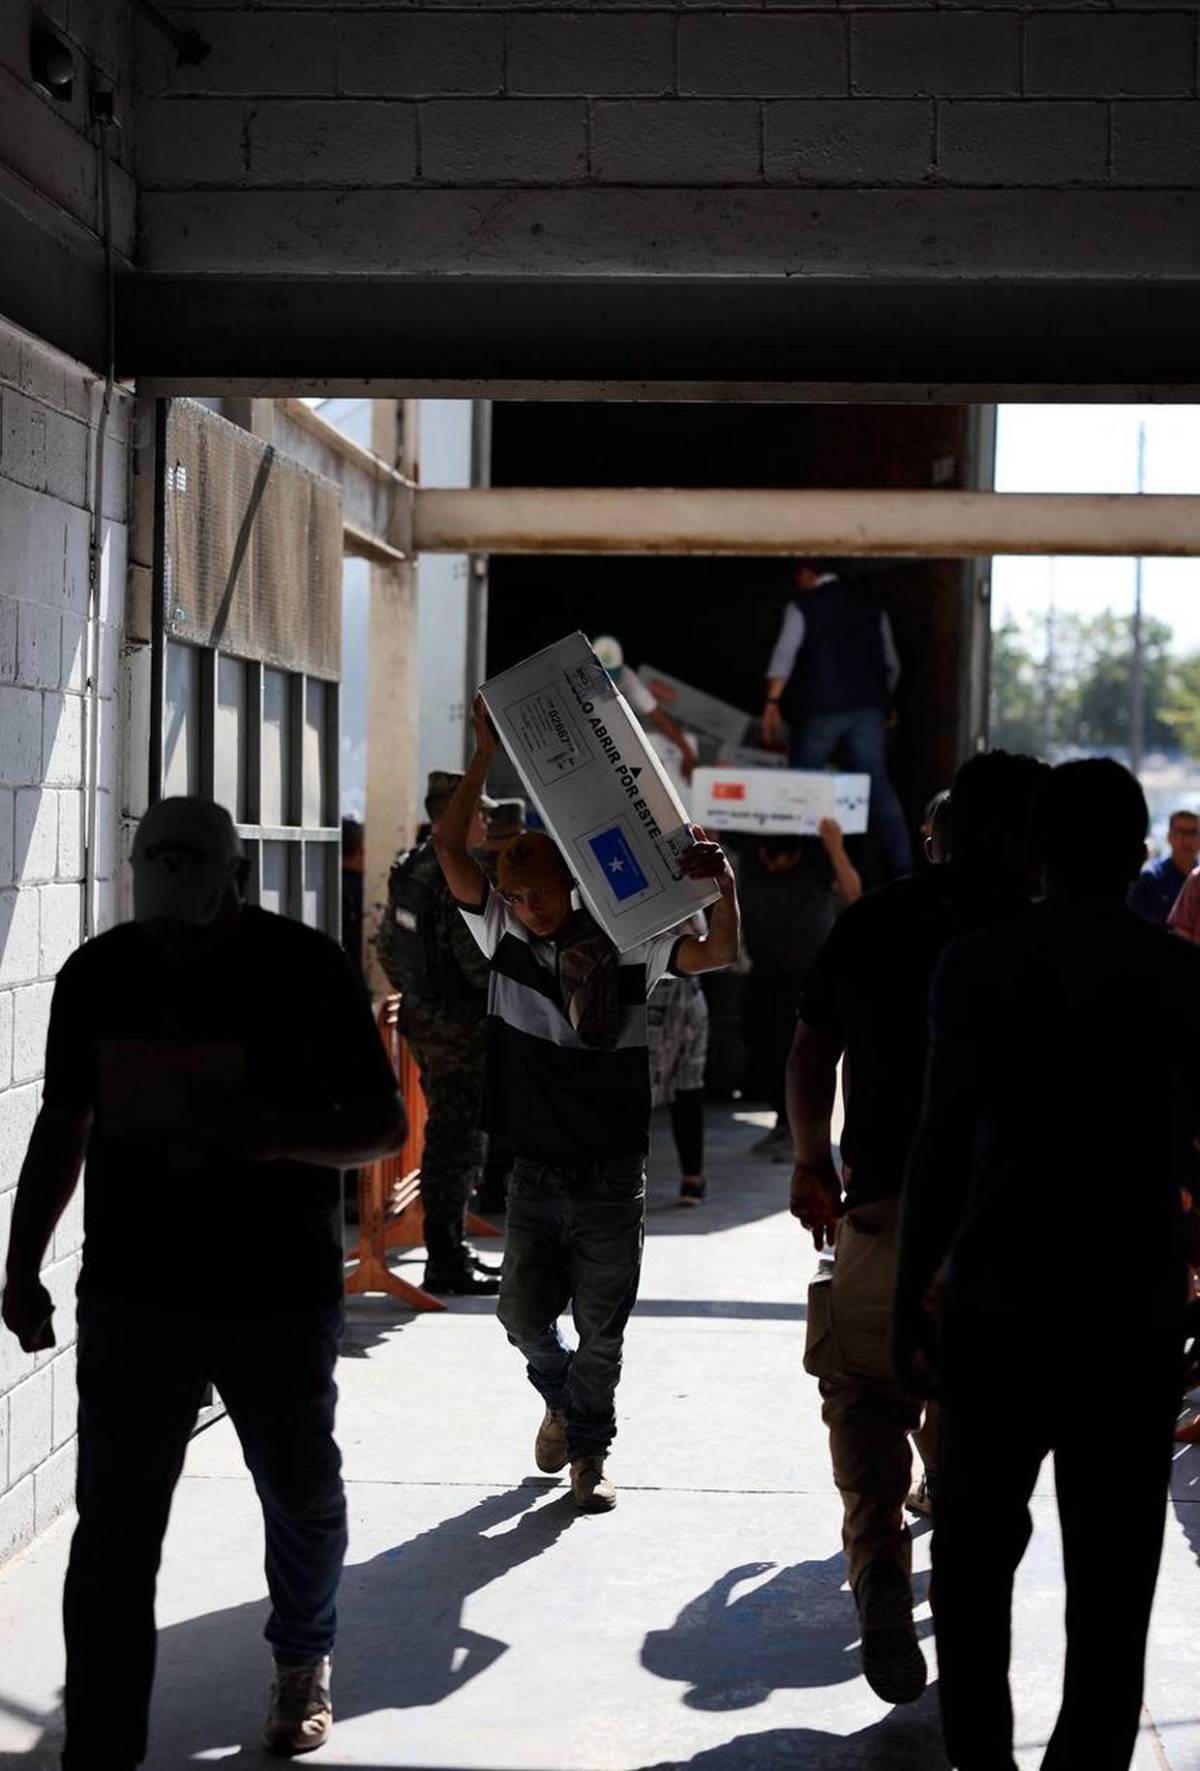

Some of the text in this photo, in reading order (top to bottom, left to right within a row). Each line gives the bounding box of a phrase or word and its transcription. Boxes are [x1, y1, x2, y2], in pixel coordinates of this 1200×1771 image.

[589, 717, 621, 764] ABRIR
[615, 765, 639, 798] POR
[633, 800, 661, 838] ESTE
